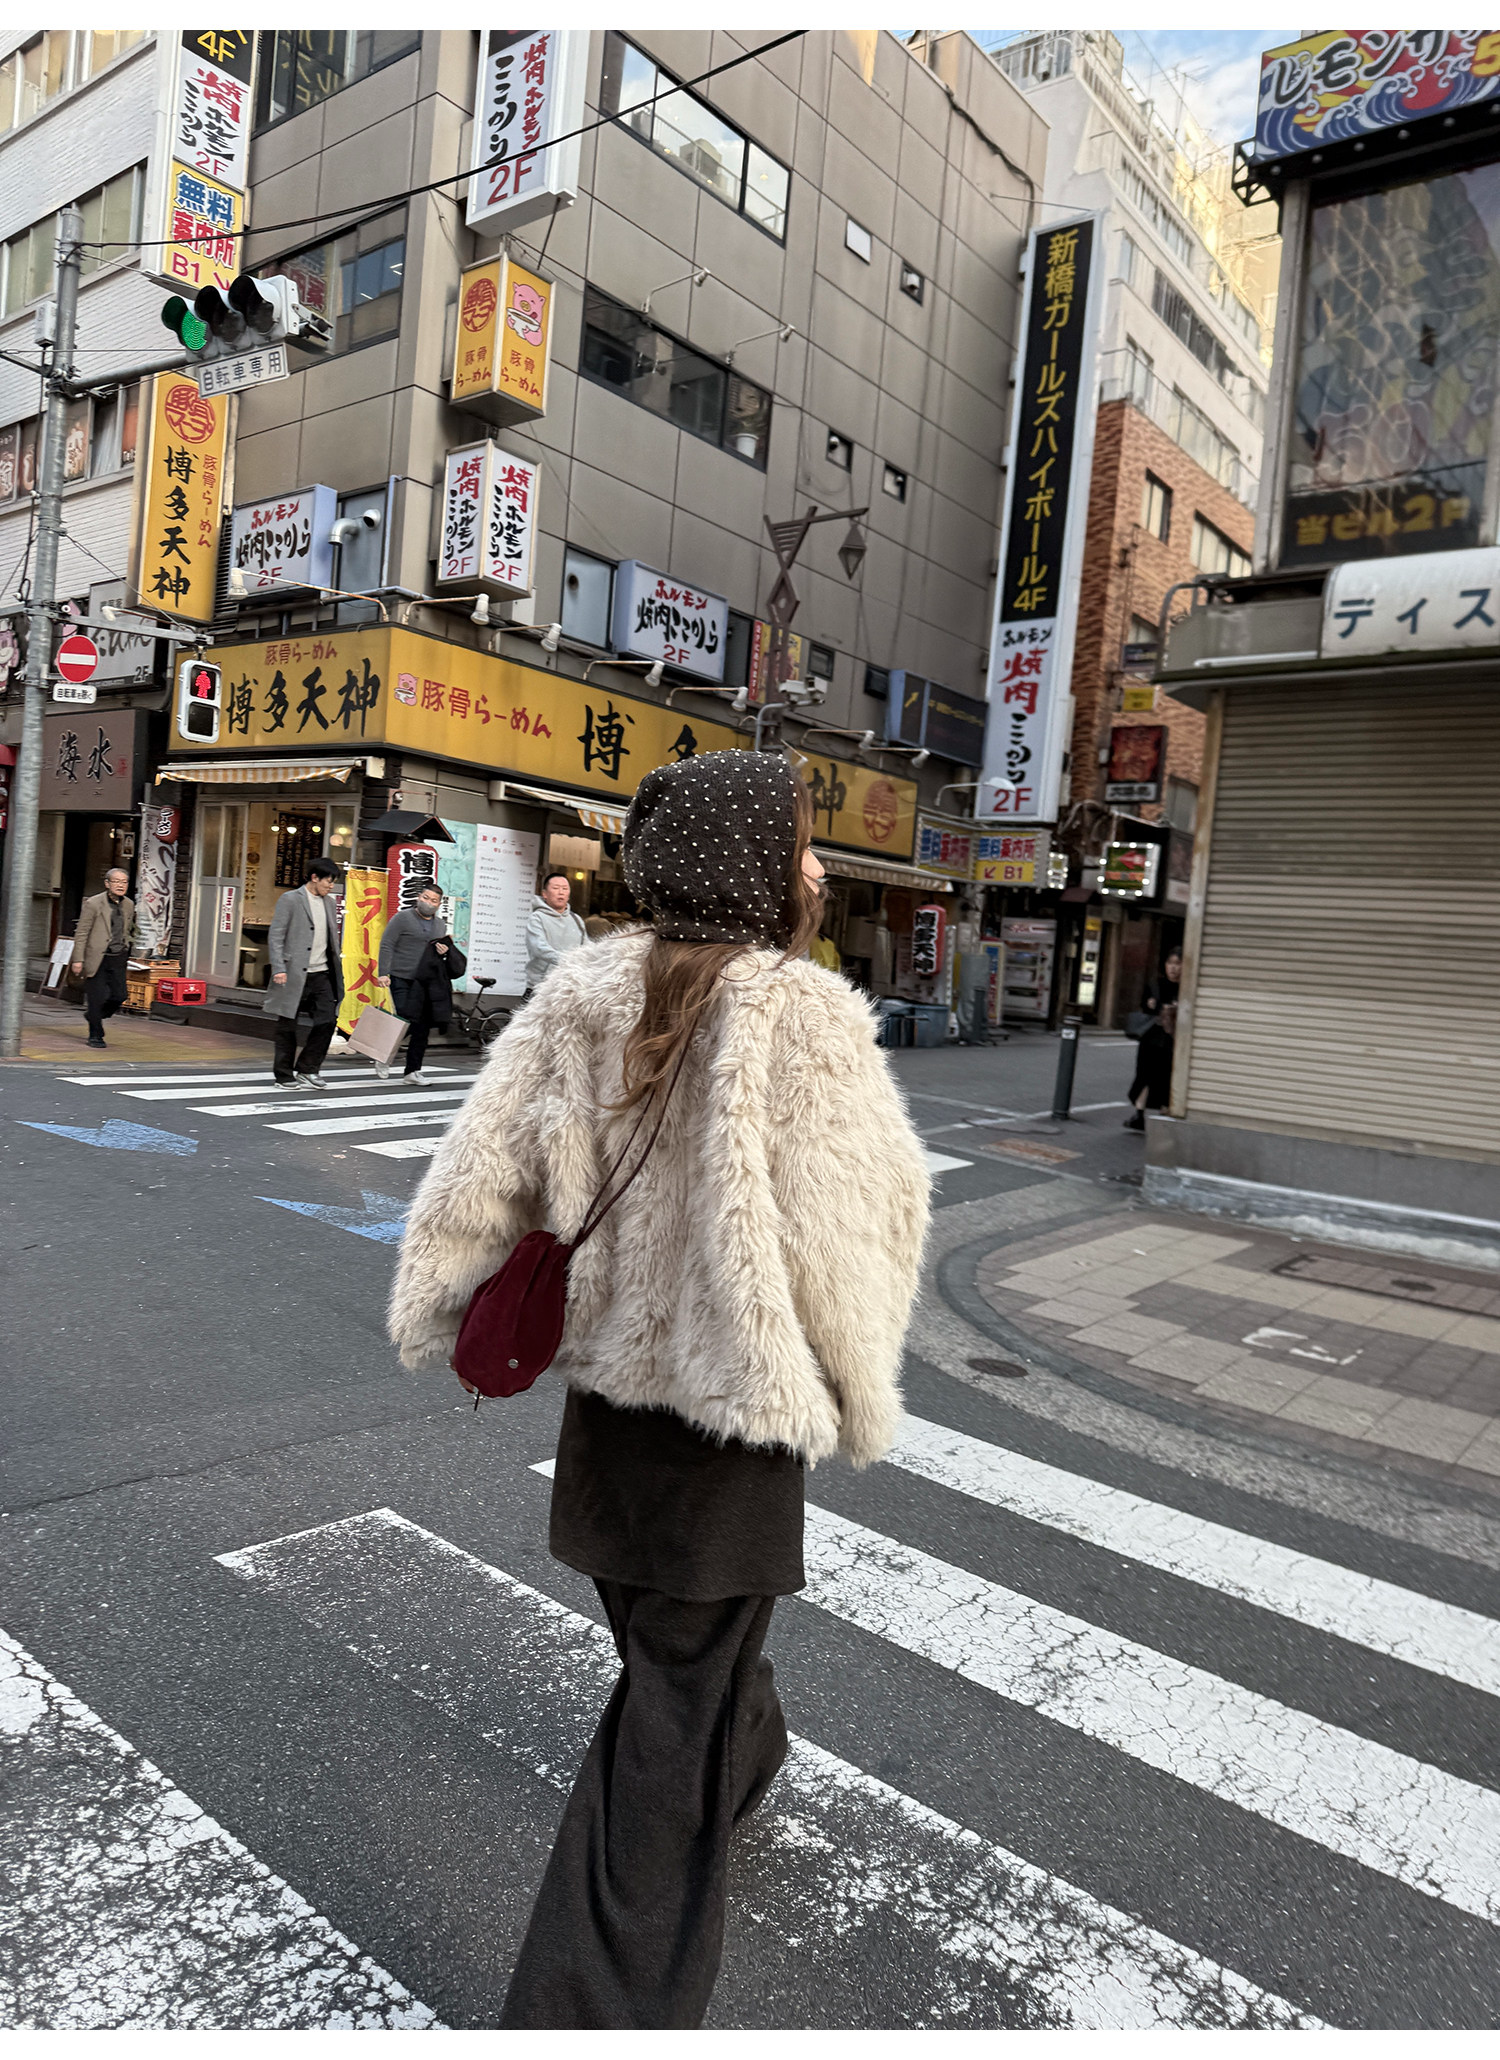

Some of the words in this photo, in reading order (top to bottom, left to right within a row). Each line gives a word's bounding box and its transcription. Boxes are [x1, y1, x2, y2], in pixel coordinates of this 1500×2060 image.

[197, 30, 237, 63] 4F
[195, 151, 229, 176] 2F
[487, 149, 538, 207] 2F
[177, 173, 235, 230] 無料
[172, 209, 236, 269] 案内所
[172, 251, 200, 283] B1
[202, 350, 282, 392] 自転車専用
[464, 345, 488, 367] 豚骨
[509, 349, 536, 375] 豚骨
[455, 367, 493, 388] らーめん
[500, 366, 541, 397] らーめん
[197, 453, 218, 549] 豚骨らーめん
[251, 498, 300, 530] ホルモン
[146, 445, 199, 609] 博多天神
[257, 566, 283, 587] 2F
[446, 556, 474, 577] 2F
[491, 560, 522, 581] 2F
[655, 579, 708, 611] ホルモン
[1013, 587, 1048, 612] 4F
[1333, 588, 1496, 640] ディス
[1003, 626, 1053, 648] ホルモン
[264, 640, 338, 667] 豚骨らーめん
[663, 644, 691, 664] 2F
[998, 645, 1049, 715] 焼肉
[225, 658, 381, 738] 博多天神
[420, 678, 552, 739] 豚骨らーめん
[993, 786, 1033, 813] 2F
[1004, 866, 1024, 880] B1
